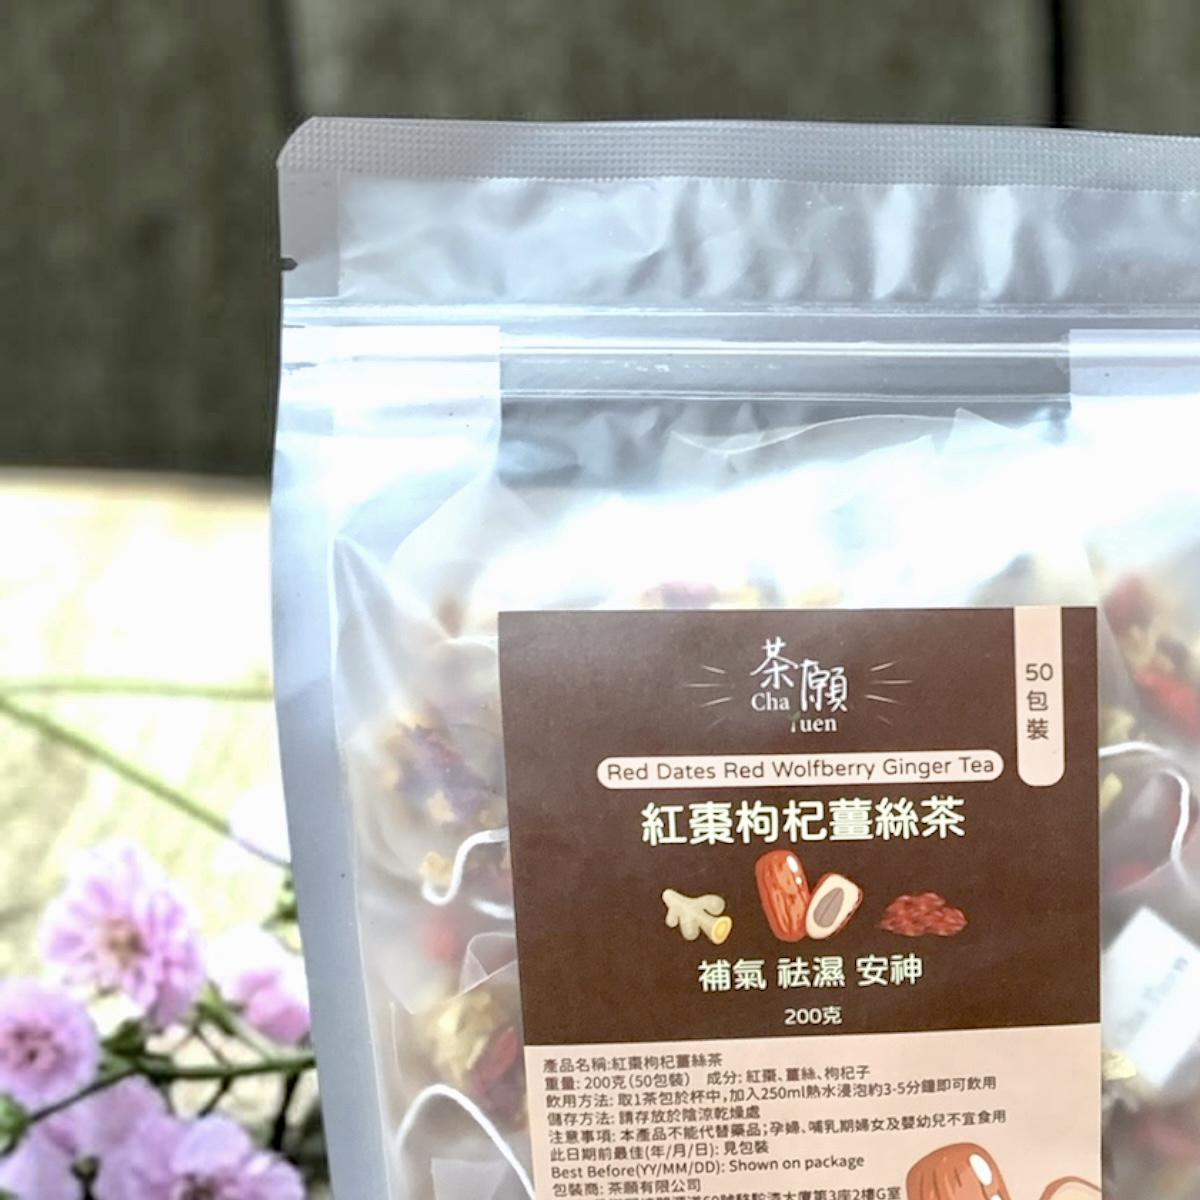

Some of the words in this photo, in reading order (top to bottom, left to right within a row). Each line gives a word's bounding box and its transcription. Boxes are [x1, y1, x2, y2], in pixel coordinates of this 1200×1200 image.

[751, 692, 790, 711] Cha
[607, 763, 649, 782] Red
[657, 761, 716, 781] Dates
[724, 760, 765, 779] Red
[771, 758, 875, 780] Wolfberry
[882, 757, 952, 779] Ginger
[958, 756, 995, 775] Tea
[641, 796, 966, 847] 紅棗枸杞薑絲茶
[698, 957, 767, 992] 補氣
[856, 954, 924, 987] 安神
[784, 1006, 843, 1026] 200克
[551, 1165, 583, 1179] Best
[587, 1161, 725, 1178] Before(YY/MM/DD):
[729, 1159, 778, 1173] Shown
[782, 1158, 800, 1170] on
[804, 1155, 865, 1172] package
